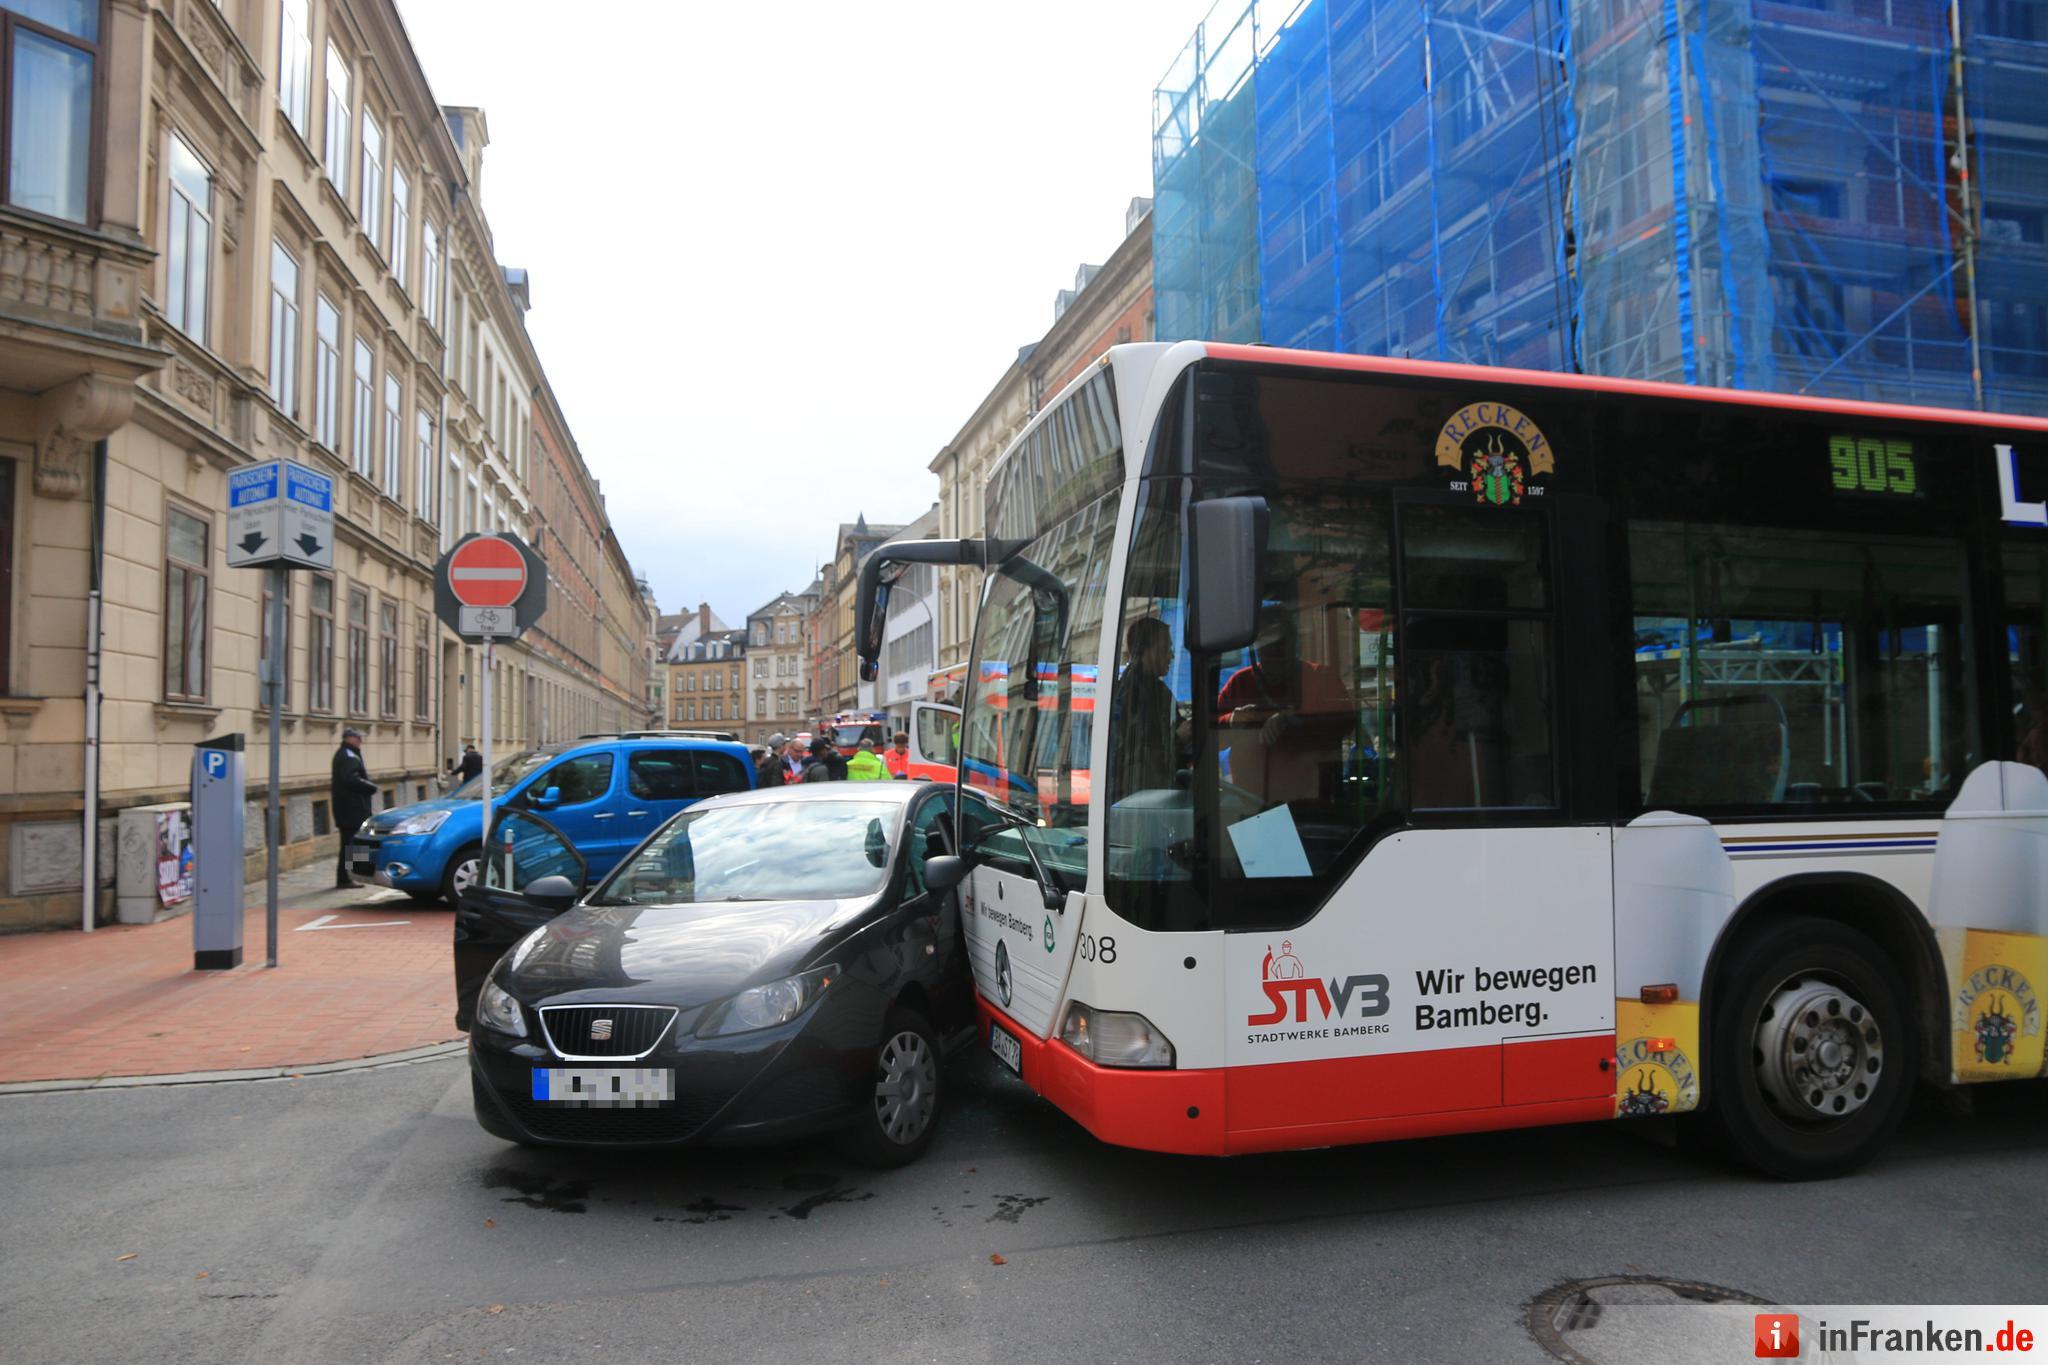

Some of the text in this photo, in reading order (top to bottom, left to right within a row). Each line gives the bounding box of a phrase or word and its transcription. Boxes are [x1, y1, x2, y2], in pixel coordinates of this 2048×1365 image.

[1444, 404, 1545, 452] RECKEN
[1829, 435, 1916, 493] 905
[1450, 481, 1545, 496] SEIT 1597
[208, 753, 224, 774] P
[988, 907, 1008, 928] bewegen
[1080, 932, 1117, 964] 308
[1415, 964, 1597, 996] Wir bewegen
[1959, 966, 2038, 1014] RECKEN
[1415, 1000, 1549, 1031] Bamberg.
[1247, 1024, 1390, 1044] STADTWERKE BAMBERG
